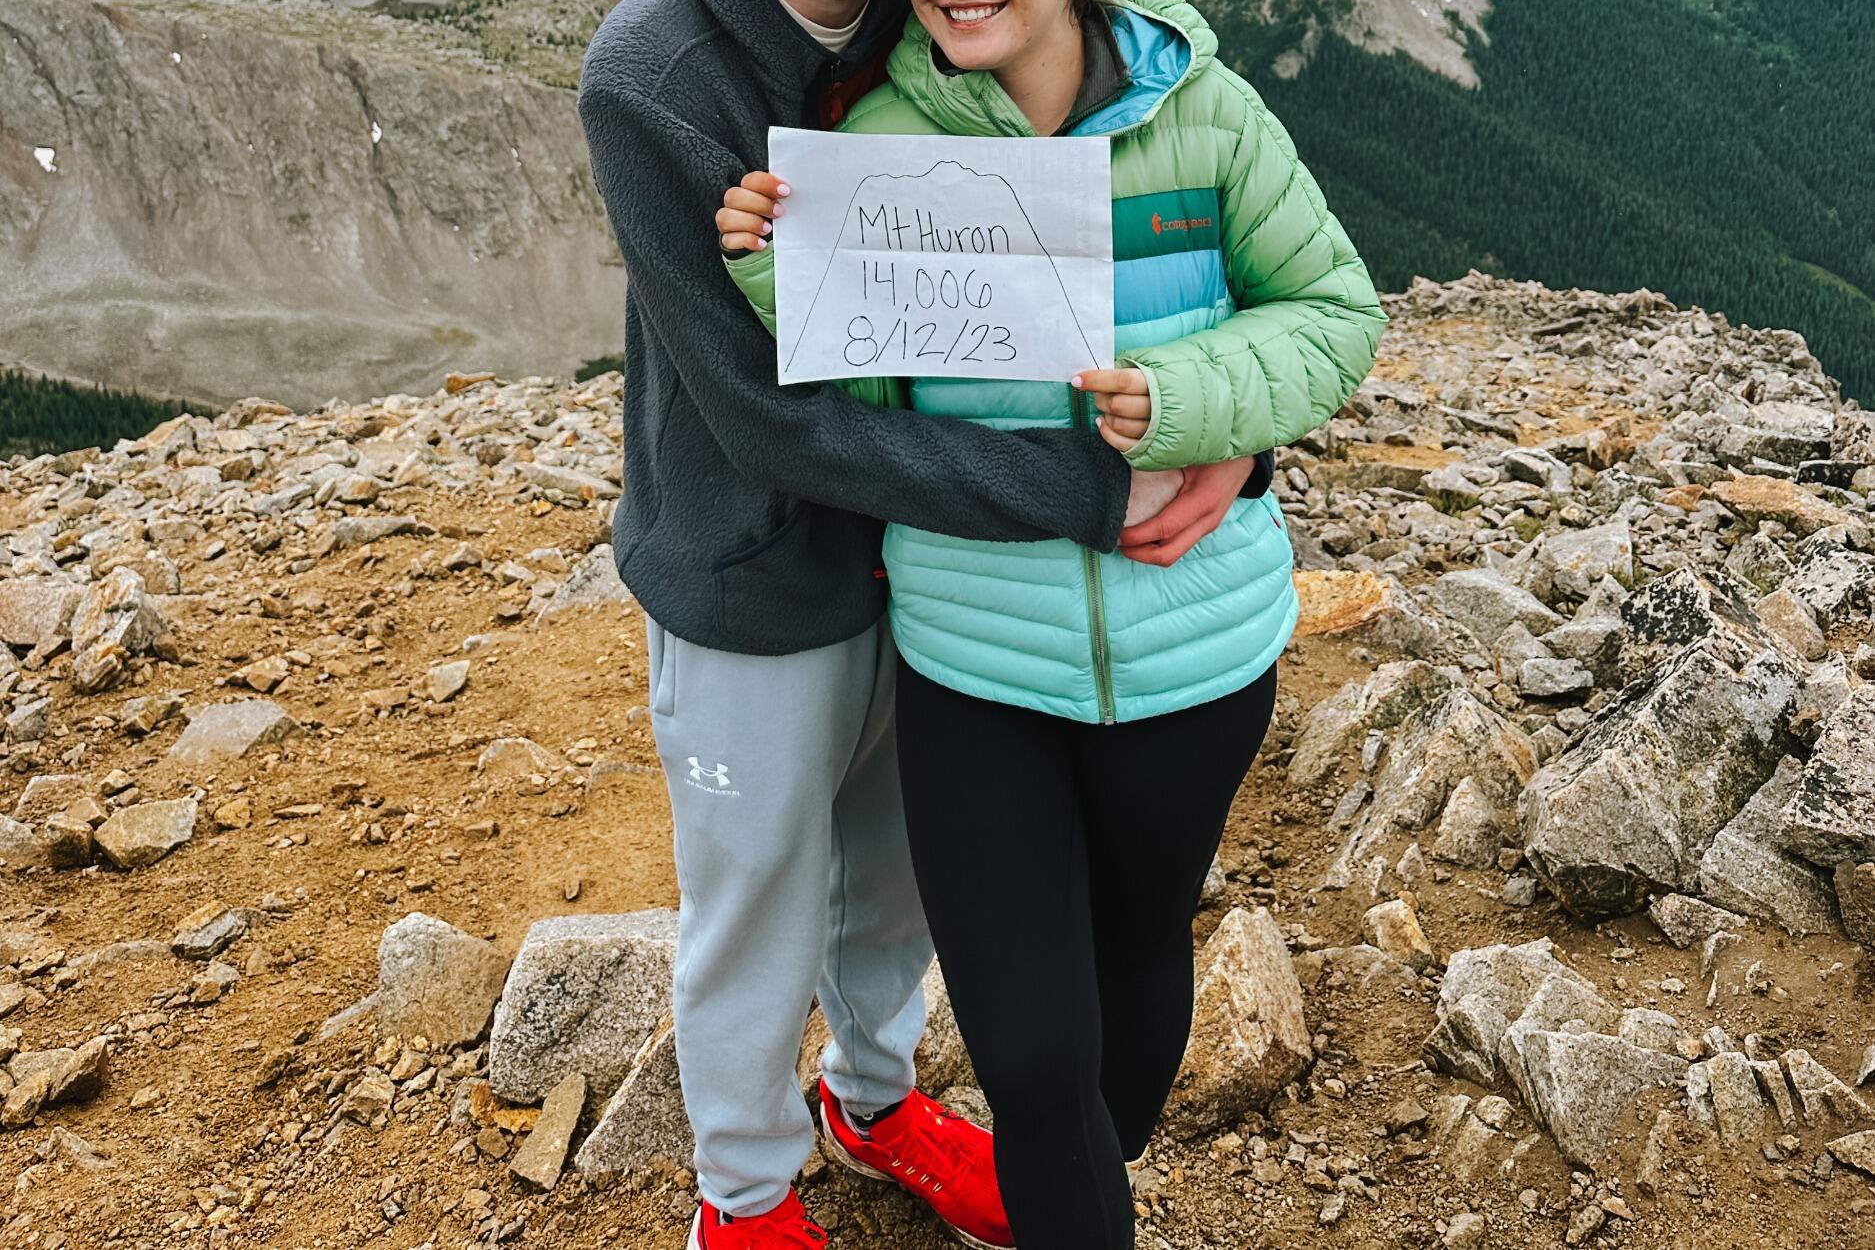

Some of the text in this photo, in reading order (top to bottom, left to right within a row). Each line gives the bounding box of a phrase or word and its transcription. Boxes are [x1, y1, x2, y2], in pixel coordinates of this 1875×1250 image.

[859, 204, 1010, 253] Mt Huron
[863, 260, 992, 312] 14,006
[844, 315, 1017, 366] 8/12/23
